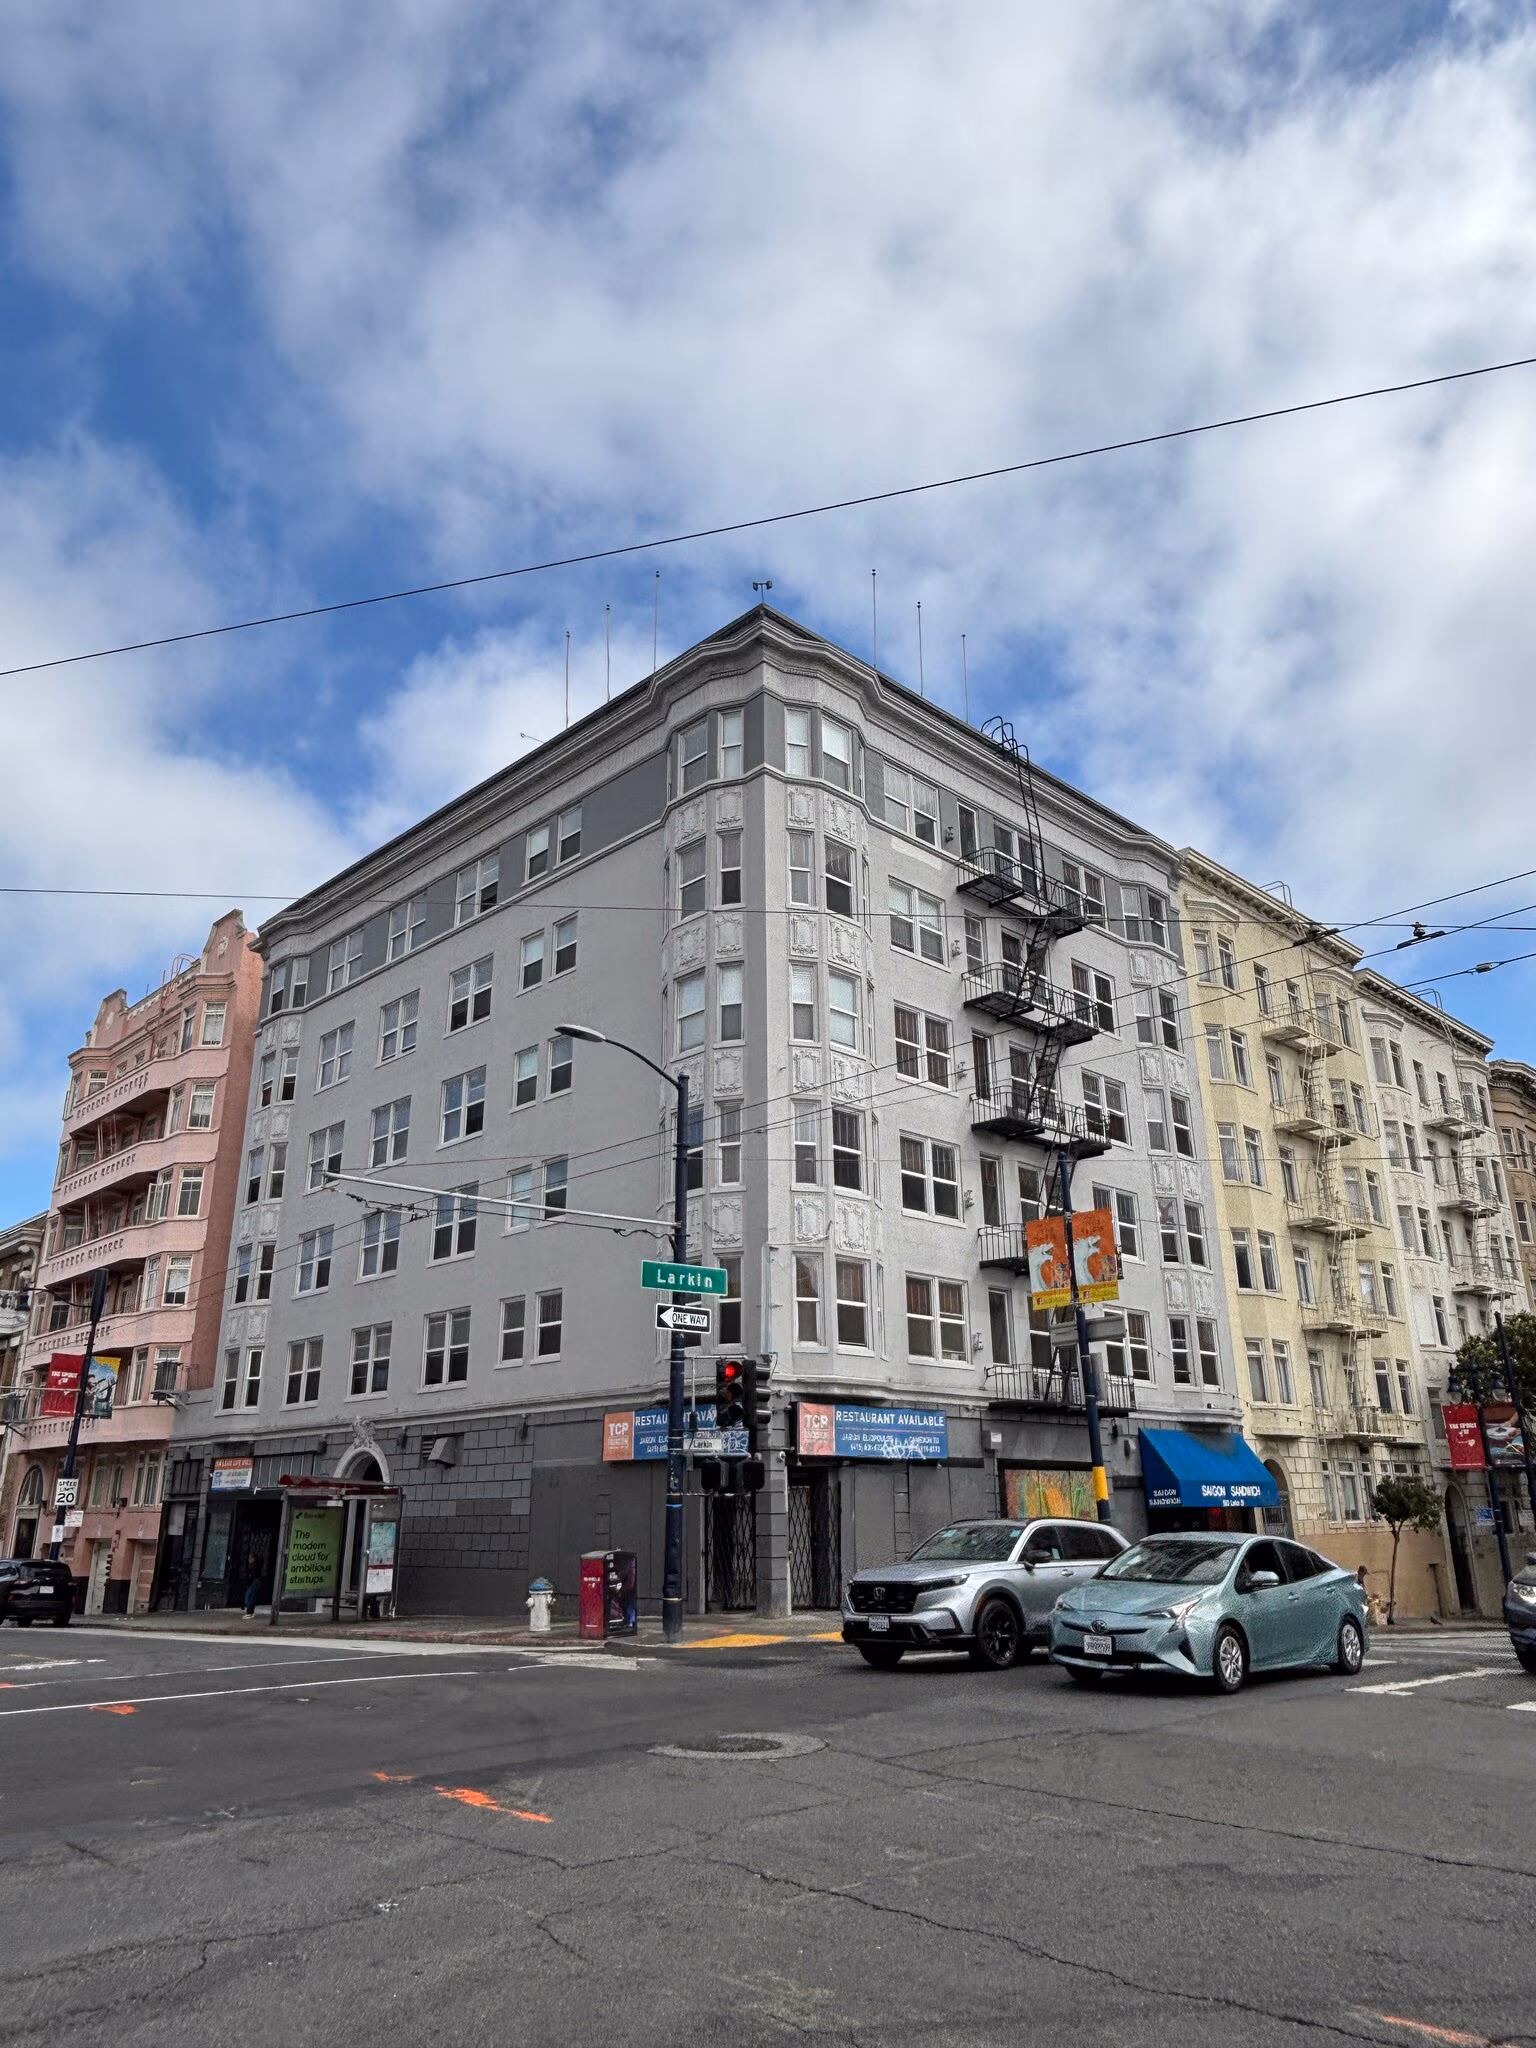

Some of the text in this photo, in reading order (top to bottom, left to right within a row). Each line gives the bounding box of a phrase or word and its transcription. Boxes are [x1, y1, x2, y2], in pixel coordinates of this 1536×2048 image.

[657, 1269, 712, 1287] Larkin
[672, 1313, 706, 1325] ONE WAY
[804, 1414, 829, 1429] TCP
[836, 1411, 944, 1426] RESTAURANT AVAILABLE
[608, 1423, 629, 1436] TCP
[693, 1438, 713, 1449] Larkin
[1202, 1485, 1261, 1497] SAIGON SANDWICH
[56, 1492, 75, 1503] 20
[295, 1530, 310, 1539] The
[293, 1541, 326, 1550] modern
[292, 1551, 330, 1561] cloud for
[290, 1562, 331, 1573] ambitious
[290, 1576, 324, 1585] startups
